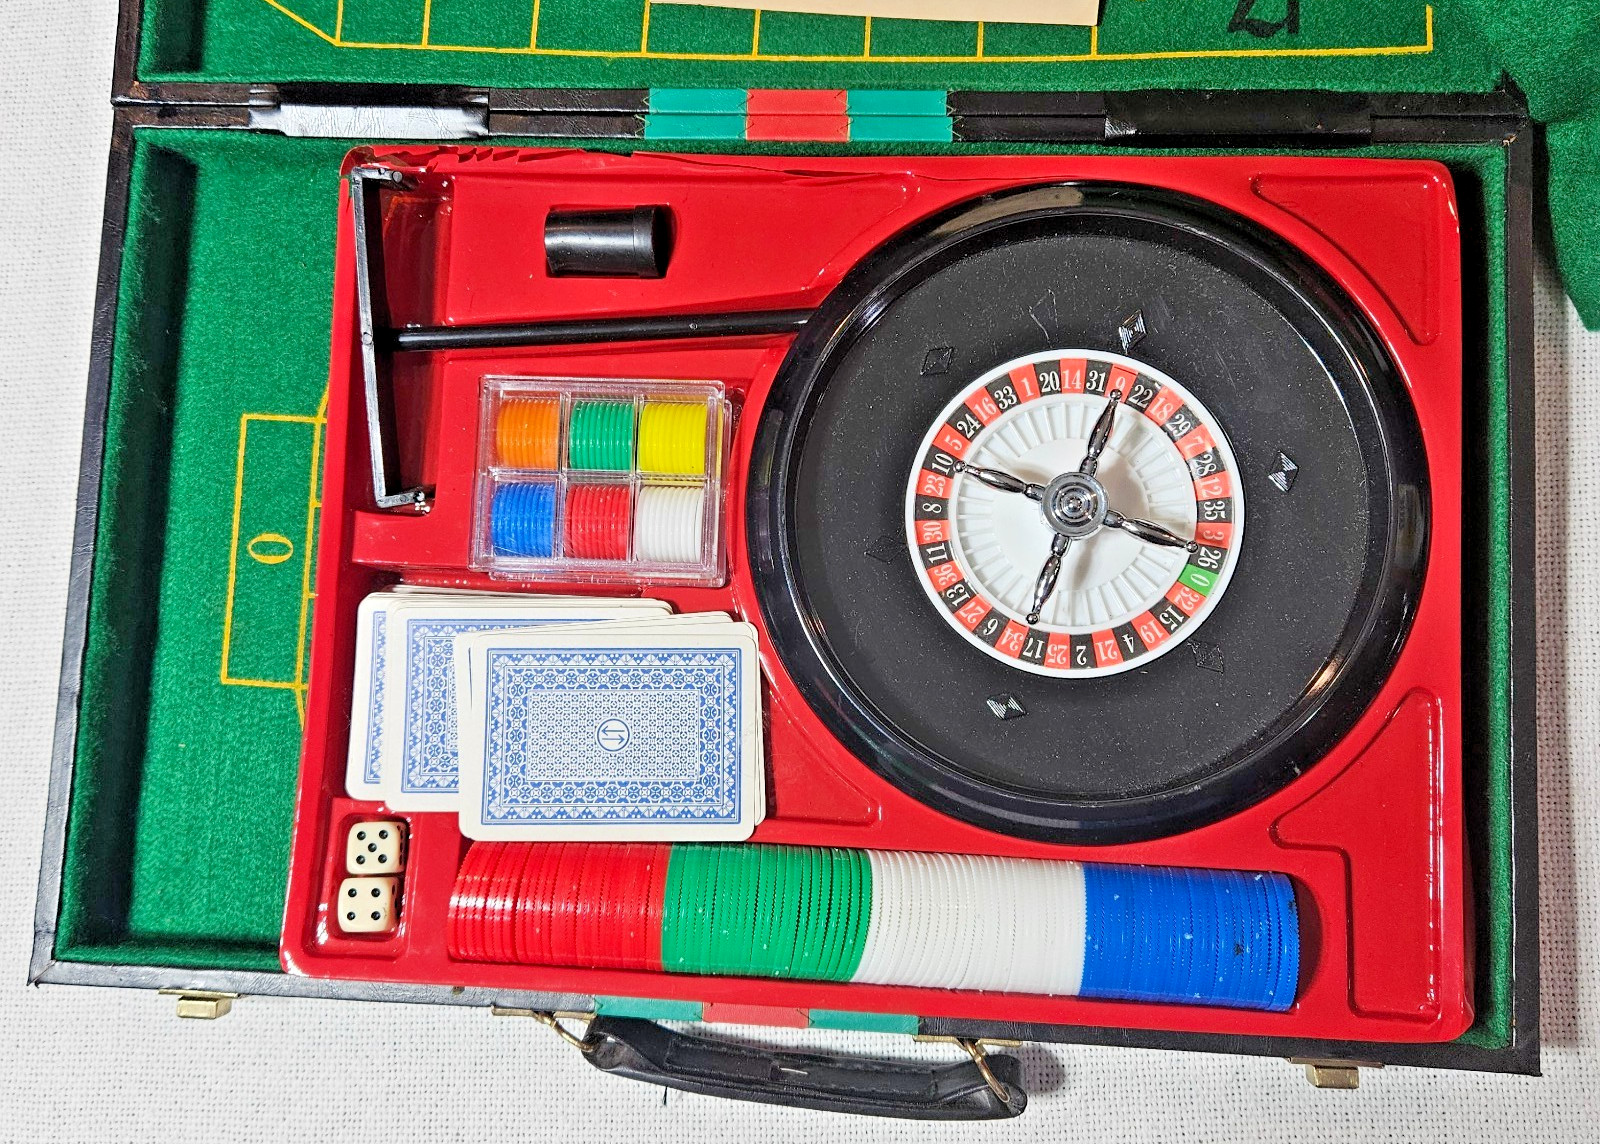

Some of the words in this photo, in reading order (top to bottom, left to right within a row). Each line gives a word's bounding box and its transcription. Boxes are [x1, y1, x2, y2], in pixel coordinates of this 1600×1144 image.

[1021, 377, 1034, 397] 1
[1039, 371, 1060, 392] 20
[1062, 369, 1081, 389] 14
[1086, 370, 1106, 392] 31
[994, 386, 1017, 409] 33
[1128, 384, 1153, 409] 22
[973, 398, 996, 421] 16
[1149, 397, 1173, 420] 18
[957, 414, 981, 439] 24
[1166, 413, 1191, 437] 29
[945, 435, 963, 451] 5
[1184, 435, 1204, 449] 7
[932, 453, 953, 475] 10
[1190, 453, 1217, 477] 28
[924, 475, 946, 497] 23
[1200, 477, 1222, 497] 12
[922, 503, 942, 513] 8
[1203, 500, 1226, 520] 35
[923, 521, 942, 541] 30
[1203, 530, 1224, 540] 3
[248, 533, 293, 564] 0
[926, 543, 948, 563] 11
[1197, 547, 1221, 569] 26
[934, 564, 957, 586] 36
[1190, 573, 1210, 587] 0
[946, 583, 970, 607] 13
[1174, 586, 1199, 611] 32
[959, 601, 985, 623] 27
[1160, 605, 1184, 631] 15
[983, 618, 998, 636] 6
[1140, 620, 1163, 643] 19
[1001, 628, 1024, 651] 34
[1023, 637, 1045, 659] 17
[1095, 639, 1118, 661] 21
[1122, 634, 1134, 653] 4
[1047, 643, 1068, 665] 25
[1076, 645, 1087, 665] 2
